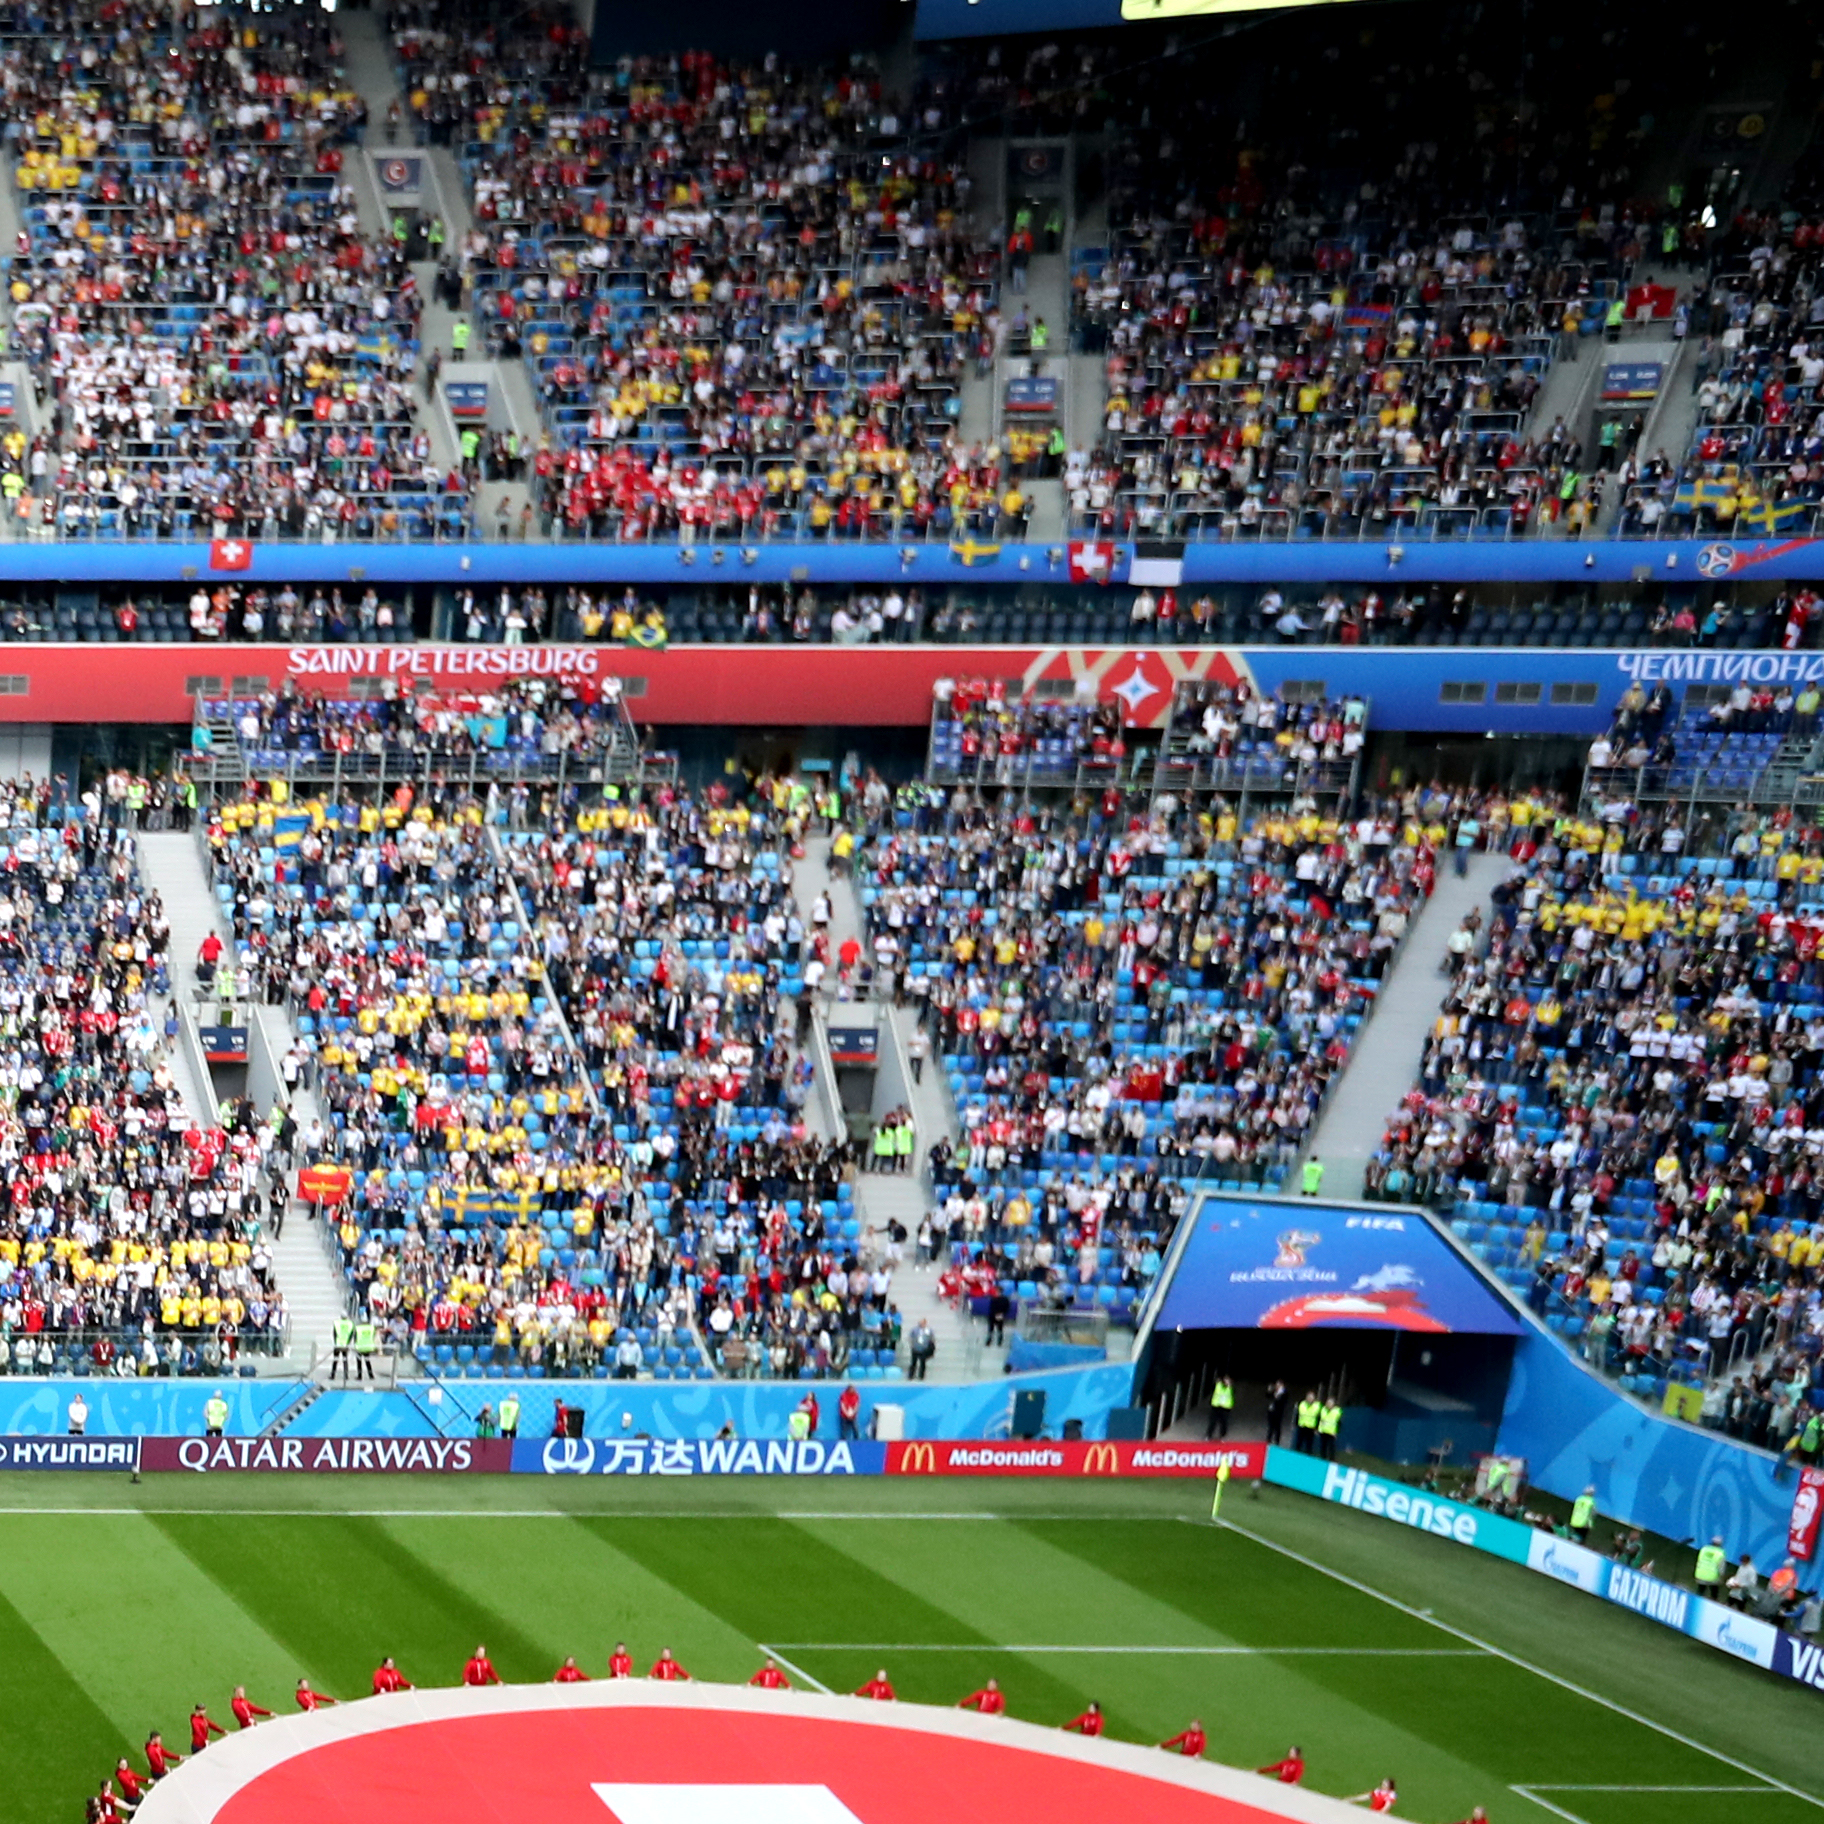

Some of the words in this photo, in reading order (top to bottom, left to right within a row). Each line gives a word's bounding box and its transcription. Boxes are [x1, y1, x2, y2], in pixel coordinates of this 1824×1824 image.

[288, 648, 382, 674] SAINT
[387, 648, 599, 675] PETERSBURG
[1345, 1216, 1406, 1232] FIFA
[13, 1442, 134, 1464] HYUNDAI
[178, 1438, 305, 1471] QATAR
[313, 1439, 473, 1470] AIRWAYS
[602, 1438, 695, 1474] 万达
[698, 1440, 855, 1474] WANDA
[948, 1447, 1064, 1467] McDonald's
[1131, 1449, 1249, 1469] McDonald's
[1321, 1463, 1478, 1545] Hisense
[1607, 1563, 1688, 1628] GAZPROM
